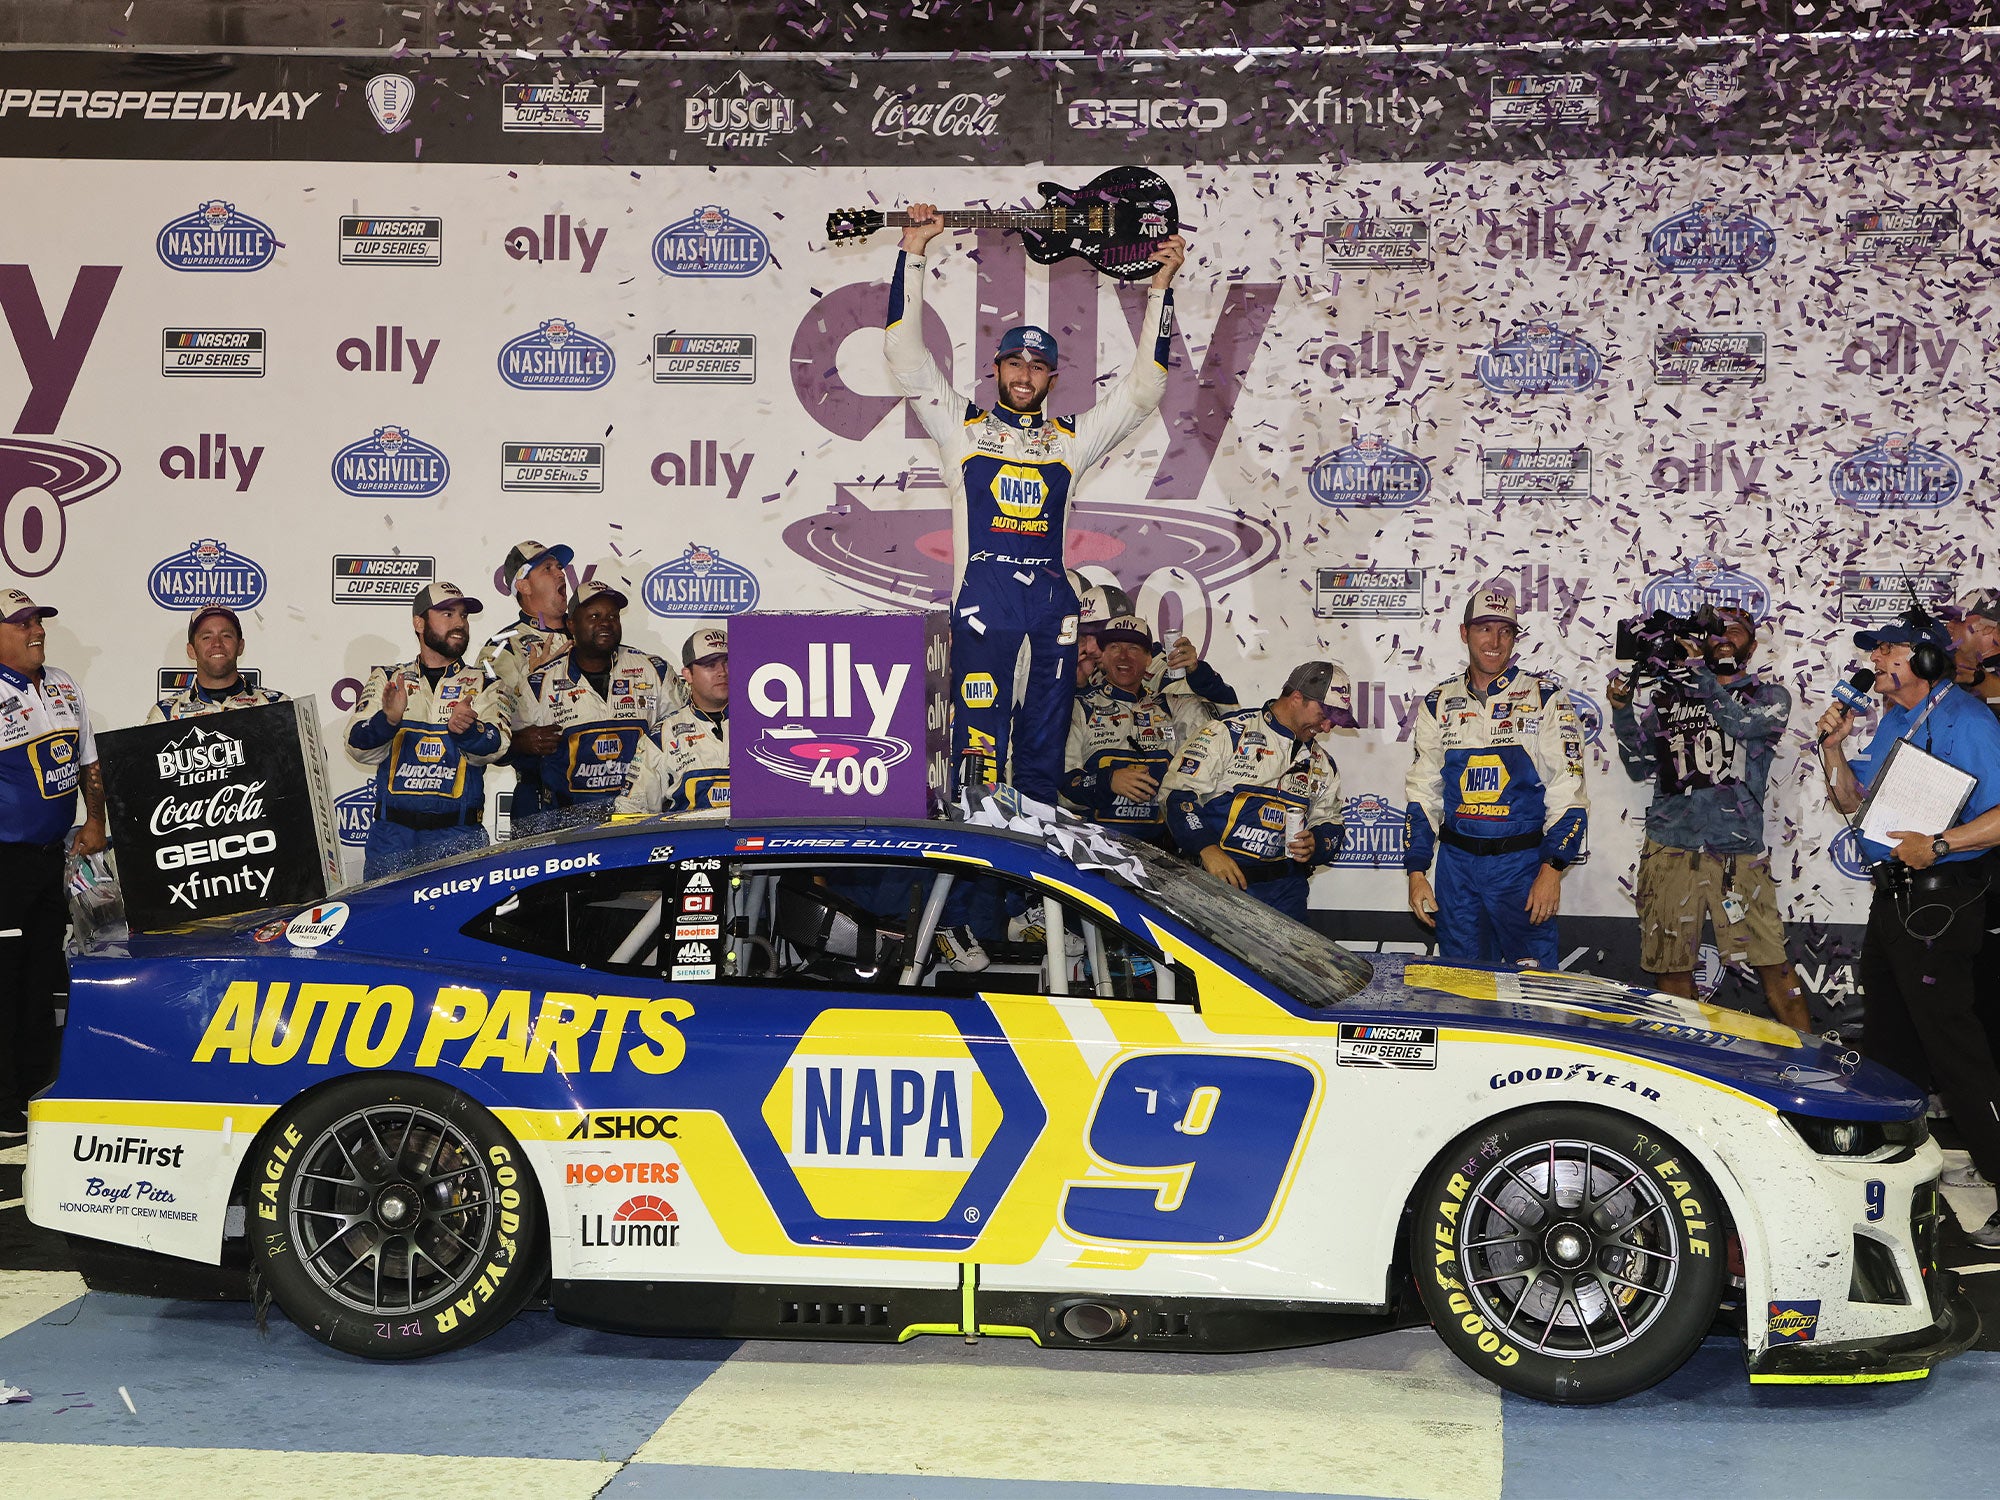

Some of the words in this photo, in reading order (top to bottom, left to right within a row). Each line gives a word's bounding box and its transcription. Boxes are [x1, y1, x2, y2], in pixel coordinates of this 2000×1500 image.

[0, 89, 323, 120] PERSPEEDWAY
[534, 88, 589, 103] NASCAR
[516, 109, 544, 122] CUP
[684, 97, 798, 135] BUSCH
[871, 93, 1006, 138] Coca-Cola
[1068, 98, 1228, 130] GEICO
[1286, 86, 1437, 136] xfinity
[704, 132, 769, 148] LIGHT
[372, 221, 426, 237] NASCAR
[1485, 207, 1590, 272] ally
[168, 231, 265, 257] NASHVILLE
[354, 240, 382, 256] CUP
[383, 240, 428, 256] SERIES
[504, 214, 608, 273] ally
[663, 237, 759, 262] NASHVILLE
[182, 257, 251, 265] SUPERSPEEDWAY
[195, 333, 250, 348] NASCAR
[685, 339, 740, 354] NASCAR
[177, 353, 204, 366] CUP
[204, 353, 251, 366] SERIES
[336, 325, 441, 385] ally
[509, 350, 605, 375] NASHVILLE
[668, 359, 695, 373] CUP
[695, 359, 741, 373] SERIES
[1319, 330, 1430, 391] ally
[1487, 352, 1590, 378] NASHVILLE
[1842, 325, 1960, 387] ally
[522, 375, 591, 384] SUPERSPEEDWAY
[159, 433, 265, 492] ally
[534, 448, 588, 462] NASCAR
[1518, 453, 1576, 469] NASCAR
[343, 457, 439, 482] NASHVILLE
[516, 468, 543, 481] CUP
[651, 440, 755, 499] ally
[1319, 467, 1420, 492] NASHVILLE
[1499, 474, 1526, 488] CUP
[1650, 442, 1766, 505] ally
[356, 482, 425, 491] SUPERSPEEDWAY
[1000, 477, 1042, 505] NAPA
[991, 516, 1017, 530] AUTO
[1018, 519, 1048, 532] PARTS
[365, 561, 419, 575] NASCAR
[996, 555, 1052, 565] ELLIOTT
[159, 571, 256, 596] NASHVILLE
[347, 580, 374, 594] CUP
[374, 580, 420, 594] SERIES
[653, 578, 750, 603] NASHVILLE
[1350, 573, 1407, 588] NASCAR
[173, 596, 243, 605] SUPERSPEEDWAY
[666, 603, 736, 612] SUPERSPEEDWAY
[1332, 594, 1361, 608] CUP
[1361, 594, 1407, 608] SERIES
[1056, 614, 1080, 646] 9
[926, 633, 948, 678] ally
[748, 642, 911, 738] ally
[965, 682, 993, 700] NAPA
[927, 693, 948, 737] ally
[1354, 681, 1426, 742] lly
[419, 743, 442, 757] NAPA
[597, 740, 620, 754] NAPA
[155, 739, 246, 780] BUSCH
[395, 762, 456, 780] AUTOCARE
[574, 762, 631, 778] AUTOCAR
[928, 750, 948, 791] ally
[178, 767, 229, 787] LIGHT
[403, 777, 442, 790] CENTER
[585, 775, 623, 788] CENTER
[810, 756, 889, 796] 400
[1465, 767, 1499, 792] NAPA
[150, 779, 267, 836] Coca-Cola
[1114, 806, 1151, 818] CENTER
[1262, 807, 1285, 825] NAPA
[1456, 804, 1477, 815] AUTO
[1479, 804, 1511, 816] PARTS
[155, 829, 277, 870] GEICO
[767, 838, 850, 848] CHASE
[851, 840, 957, 851] ELLIOTT
[168, 866, 275, 910] xfinity
[413, 874, 485, 904] Kelley
[488, 862, 543, 886] Blue
[545, 852, 601, 874] Book
[288, 923, 337, 938] VALVOLINE
[677, 928, 716, 937] HOOTERS
[677, 941, 712, 958] MAC
[676, 969, 711, 977] SIEMENS
[192, 981, 416, 1068] AUTO
[415, 988, 697, 1075] PARTS
[1370, 1026, 1422, 1042] NASCAR
[1351, 1043, 1378, 1057] CUP
[1378, 1045, 1423, 1059] SERIES
[804, 1066, 964, 1159] NAPA
[566, 1113, 679, 1140] ASHOC
[73, 1134, 185, 1169] UniFirst
[1061, 1050, 1319, 1247] 9
[258, 1123, 303, 1222] EAGLE
[566, 1162, 680, 1185] HOOTERS
[85, 1176, 133, 1203] Boyd
[136, 1180, 176, 1203] Pitts
[1864, 1179, 1886, 1223] 9
[59, 1202, 114, 1214] HONORARY
[116, 1205, 130, 1216] PIT
[131, 1206, 158, 1218] CREW
[159, 1209, 198, 1222] MEMBER
[1653, 1160, 1711, 1258] EAGLE
[581, 1214, 680, 1247] LLumar
[1768, 1315, 1816, 1331] SUNOCO
